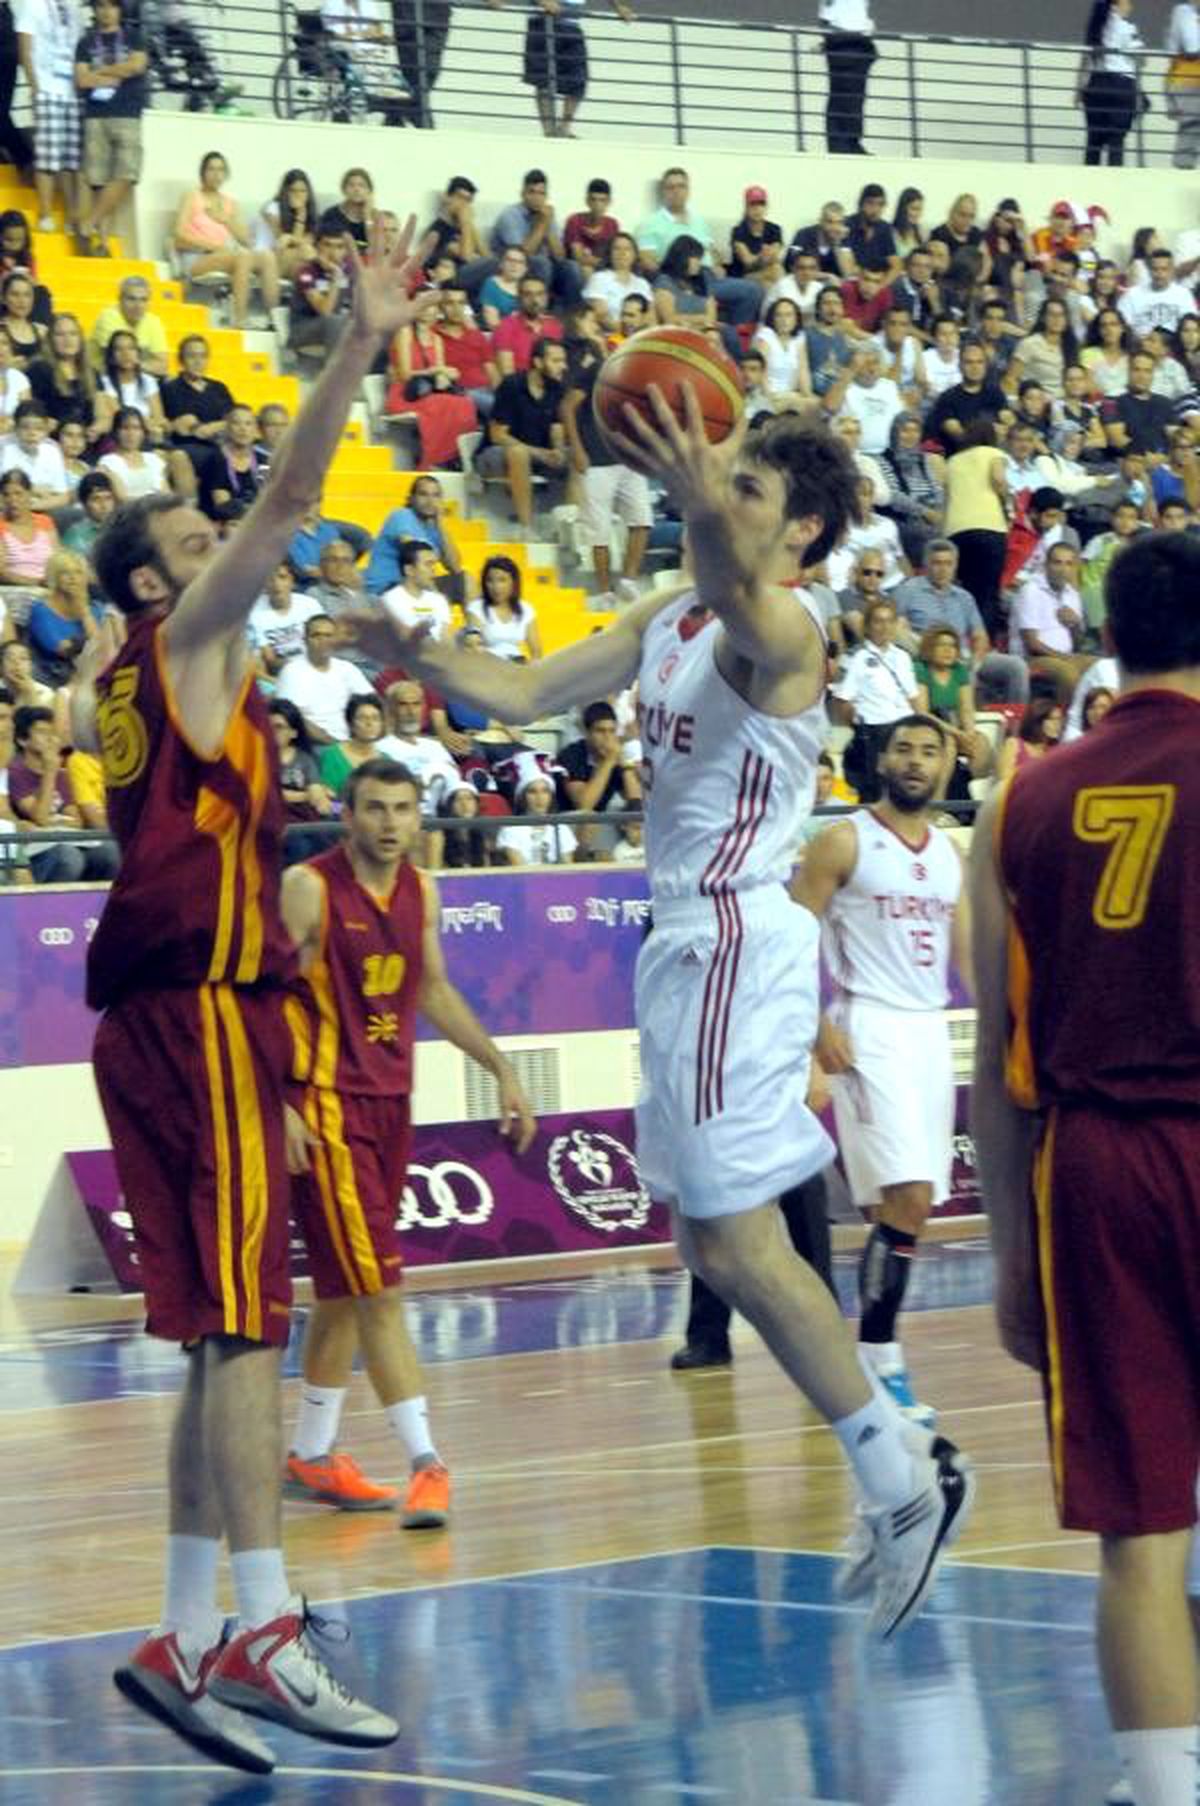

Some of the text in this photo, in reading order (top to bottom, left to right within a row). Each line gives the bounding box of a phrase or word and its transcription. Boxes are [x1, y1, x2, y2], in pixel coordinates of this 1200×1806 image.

[1073, 784, 1176, 928] 7
[908, 930, 934, 967] 15
[363, 952, 406, 996] 10
